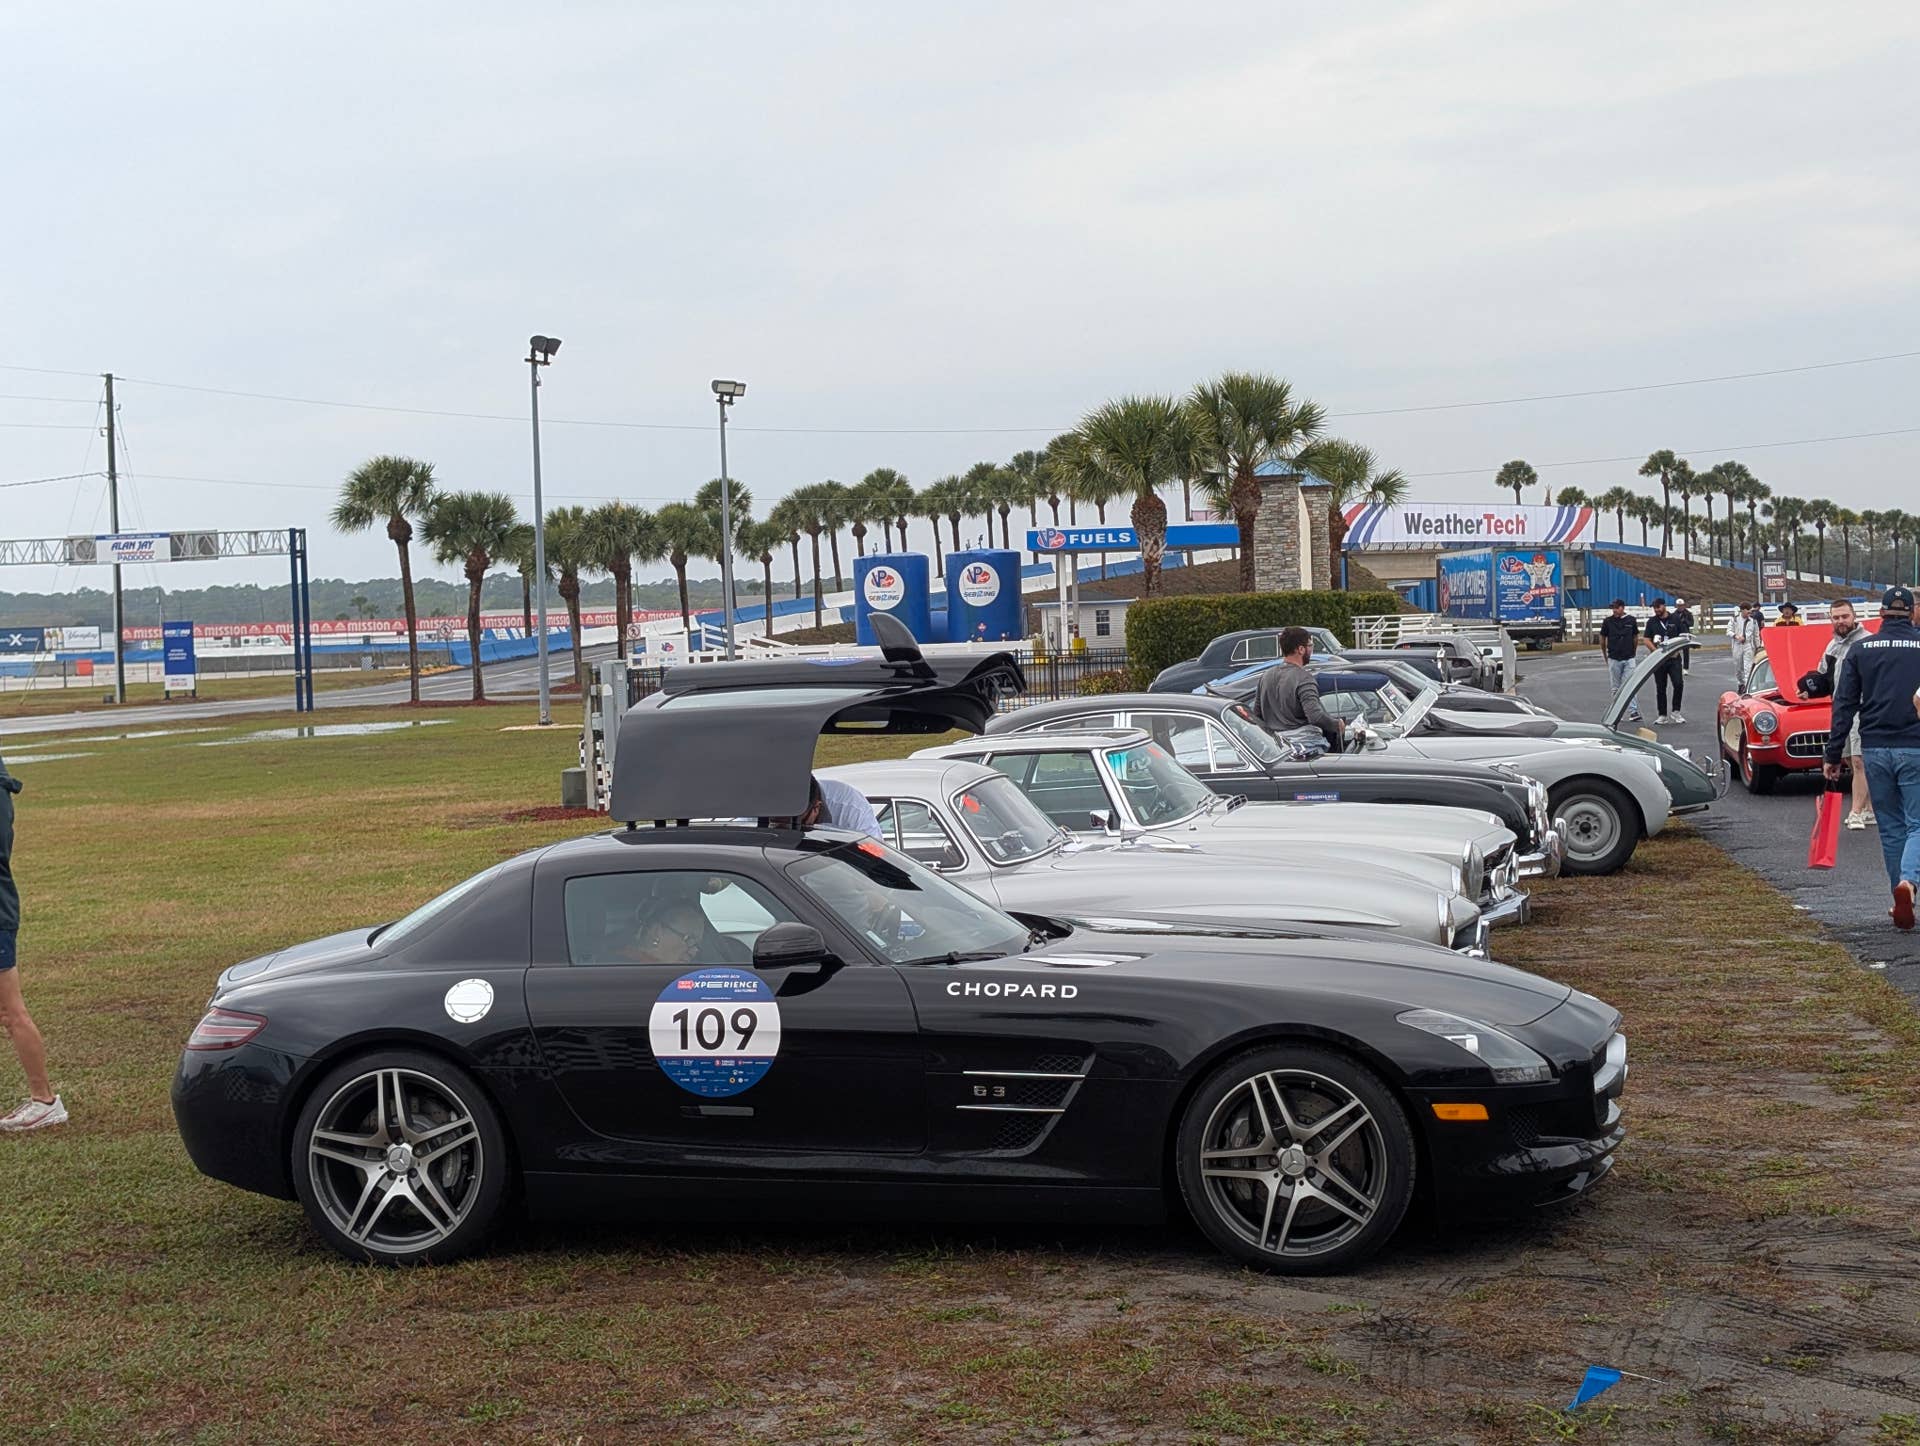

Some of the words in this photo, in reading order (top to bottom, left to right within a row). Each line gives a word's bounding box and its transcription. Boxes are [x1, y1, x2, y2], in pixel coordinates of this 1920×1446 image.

[1403, 512, 1526, 535] WeatherTech
[111, 541, 136, 551] ALAN
[137, 540, 154, 551] JAY
[1069, 532, 1131, 545] FUELS
[1862, 639, 1890, 649] TEAM
[946, 981, 1078, 999] CHOPARD
[672, 1007, 758, 1051] 109
